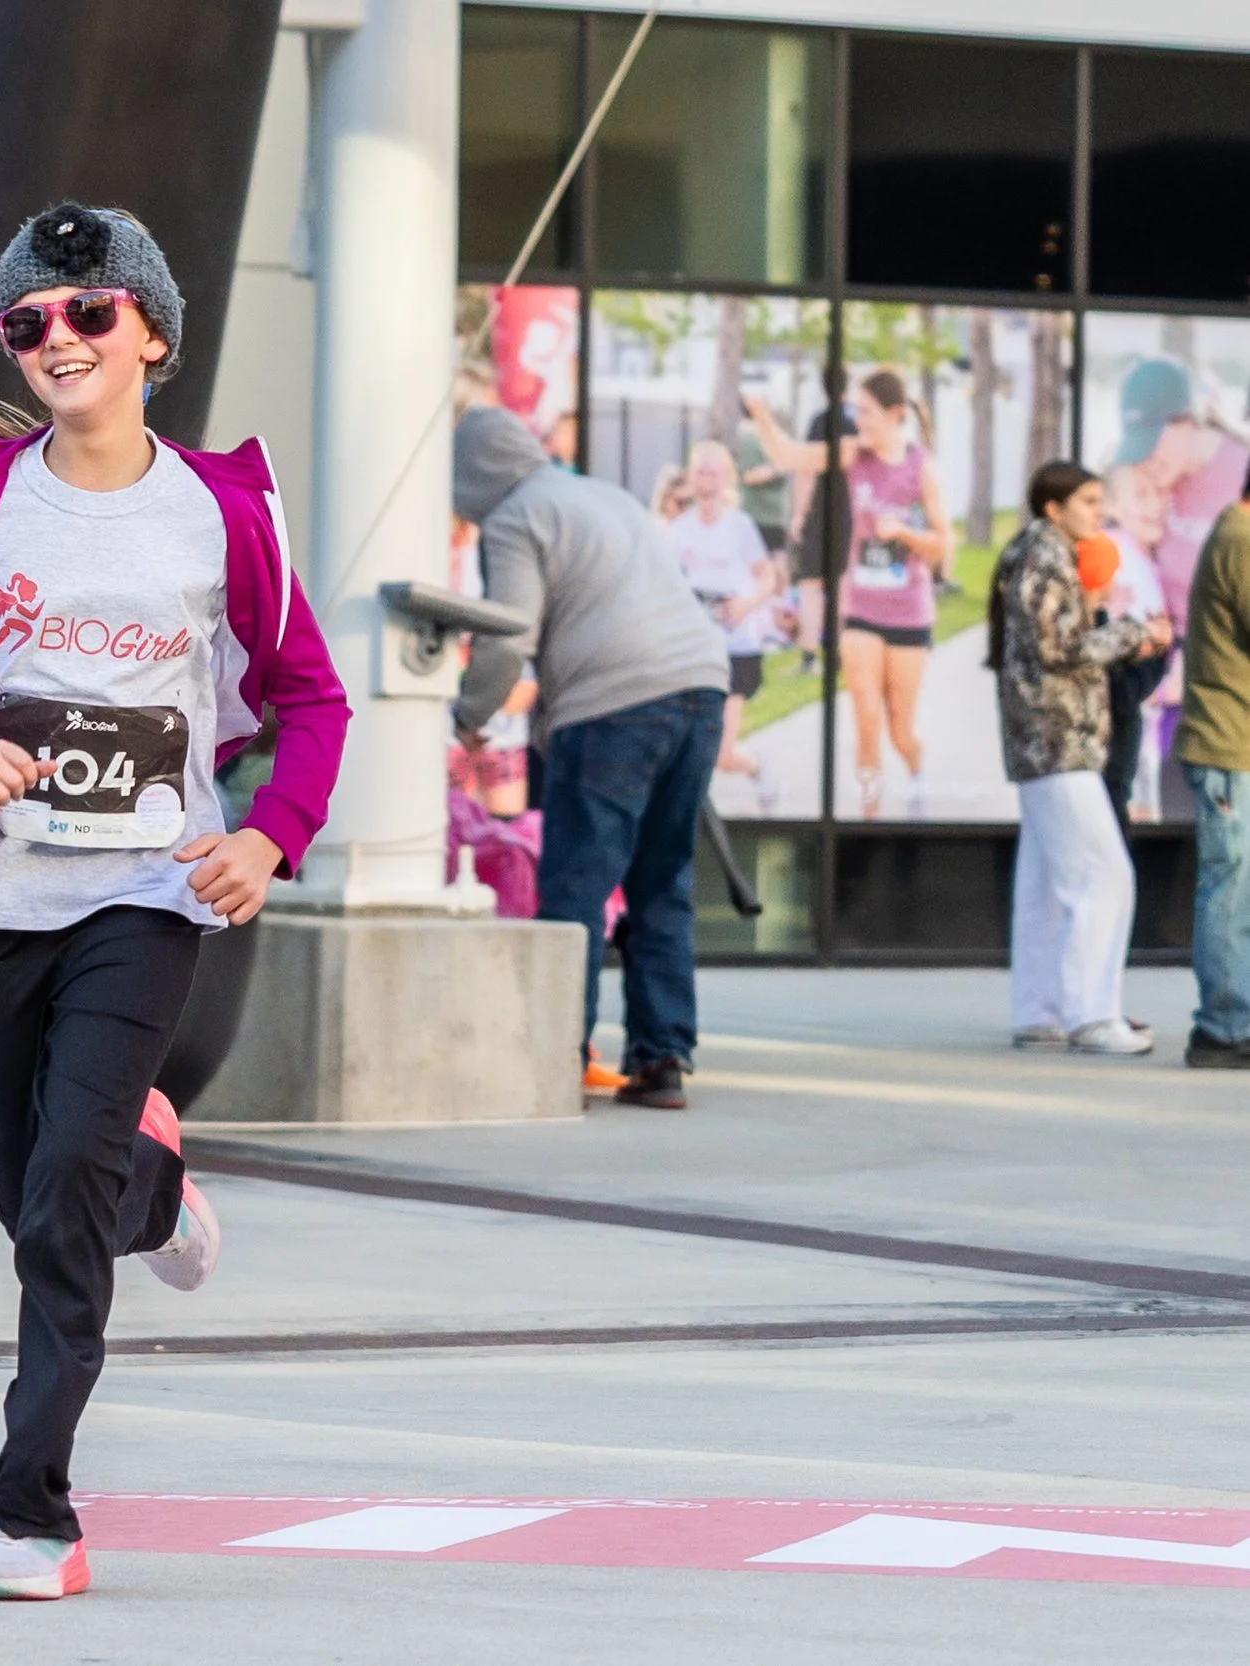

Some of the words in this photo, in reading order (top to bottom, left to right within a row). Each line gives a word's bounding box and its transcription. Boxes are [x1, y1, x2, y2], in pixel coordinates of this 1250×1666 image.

[39, 616, 191, 662] BIOGirls
[81, 719, 119, 733] BIOGirls
[37, 746, 136, 797] 104
[75, 824, 91, 834] ND
